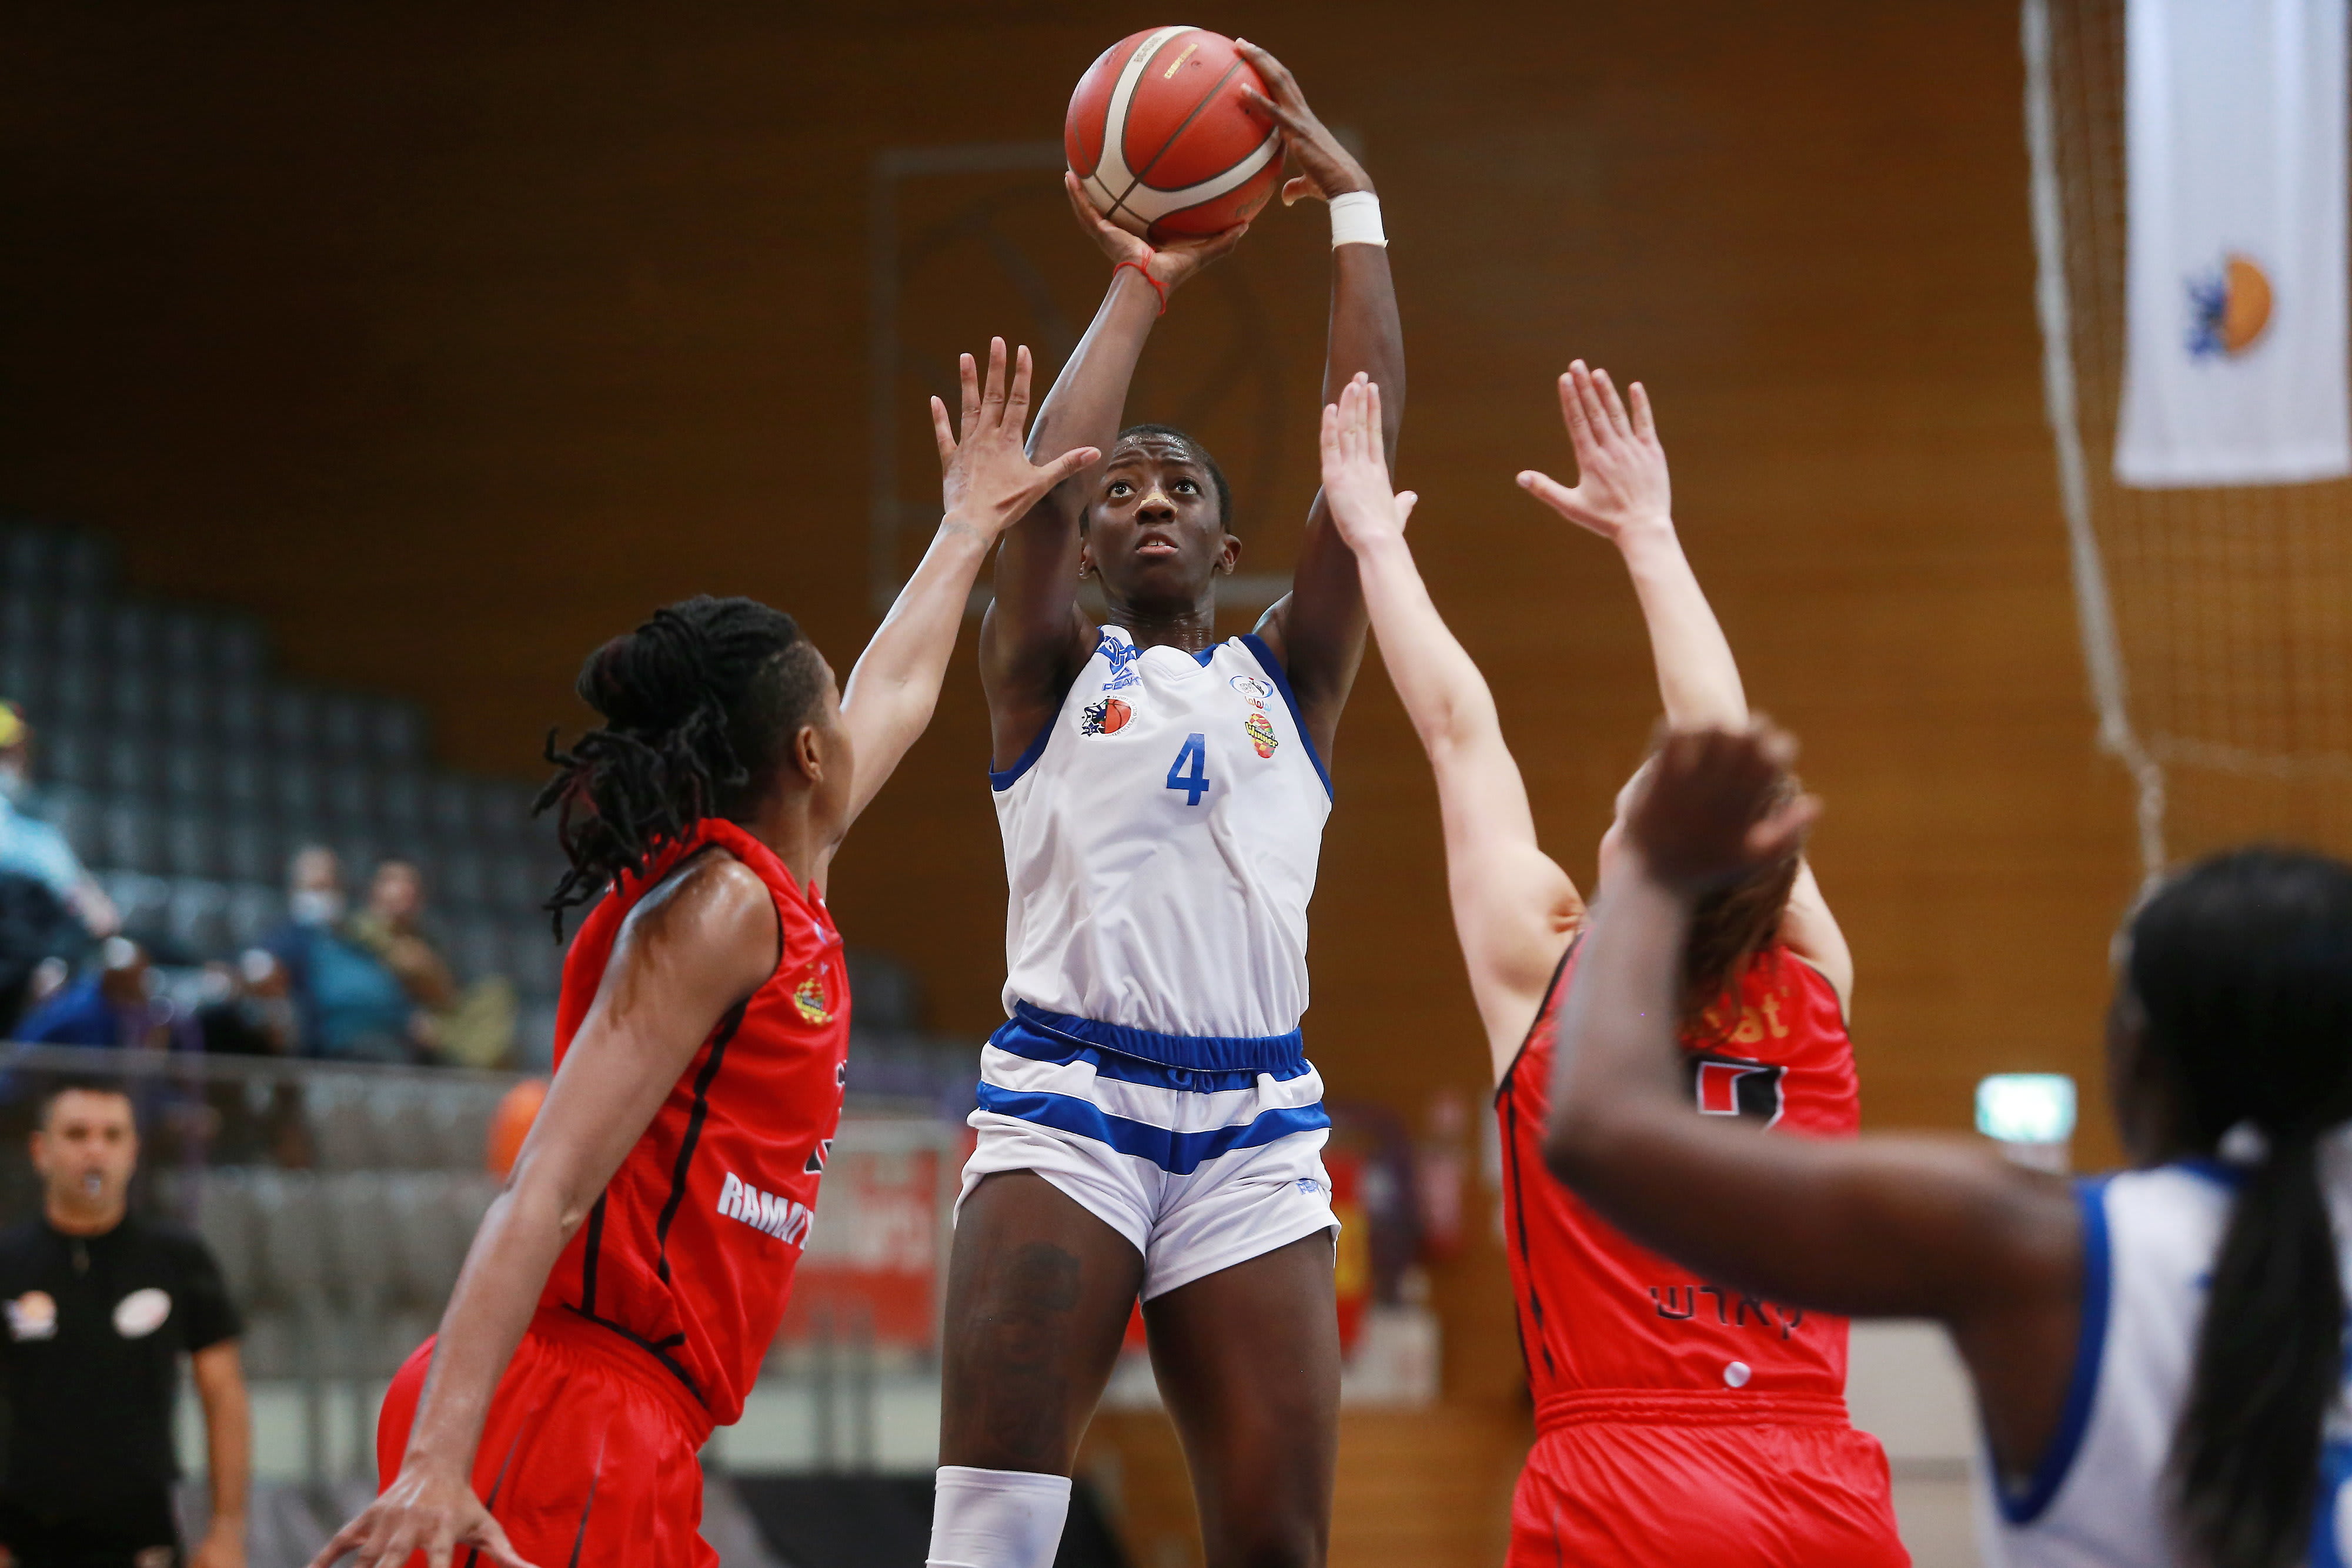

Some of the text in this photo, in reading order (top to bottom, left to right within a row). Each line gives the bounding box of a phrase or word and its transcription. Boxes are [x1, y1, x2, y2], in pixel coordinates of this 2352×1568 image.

[1102, 676, 1141, 691] PEAK
[1245, 721, 1278, 748] Winner
[1166, 733, 1210, 805] 4
